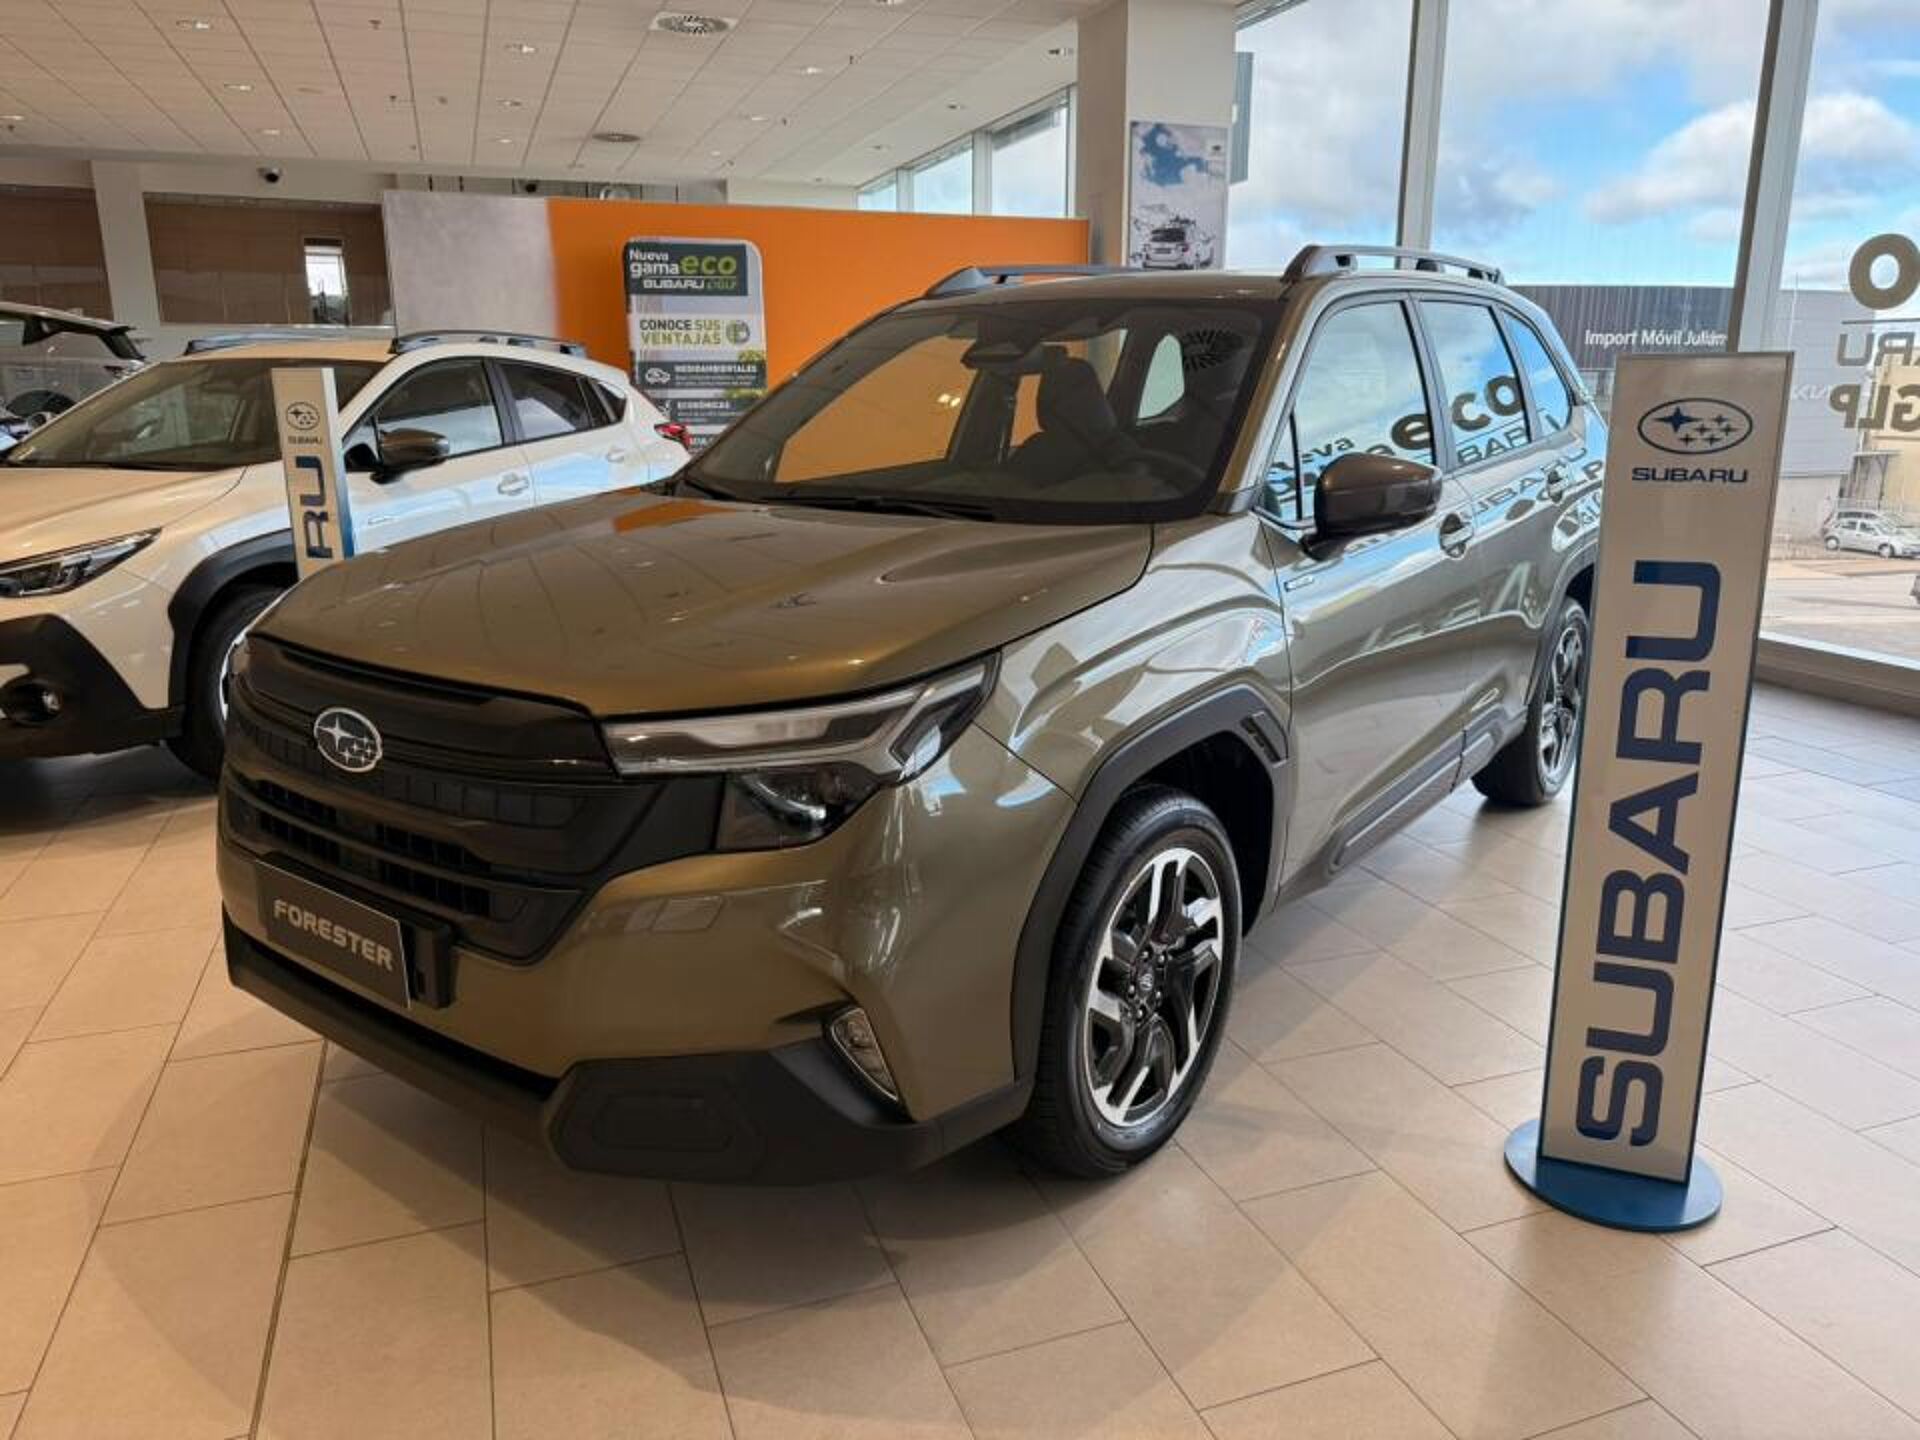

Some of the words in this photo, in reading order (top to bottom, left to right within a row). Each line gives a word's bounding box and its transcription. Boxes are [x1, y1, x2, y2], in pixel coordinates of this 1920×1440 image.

[630, 250, 668, 261] Nueva
[630, 261, 679, 278] gama
[680, 255, 737, 275] eco
[643, 279, 704, 289] SUBARU
[640, 319, 691, 331] CONOCE
[694, 319, 721, 331] SUS
[640, 332, 721, 345] VENTAJAS
[1584, 329, 1637, 348] Import
[1641, 328, 1682, 345] Móvil
[1631, 466, 1749, 484] SUBARU
[1575, 559, 1722, 1148] SUBARU
[273, 899, 393, 972] FORESTER
